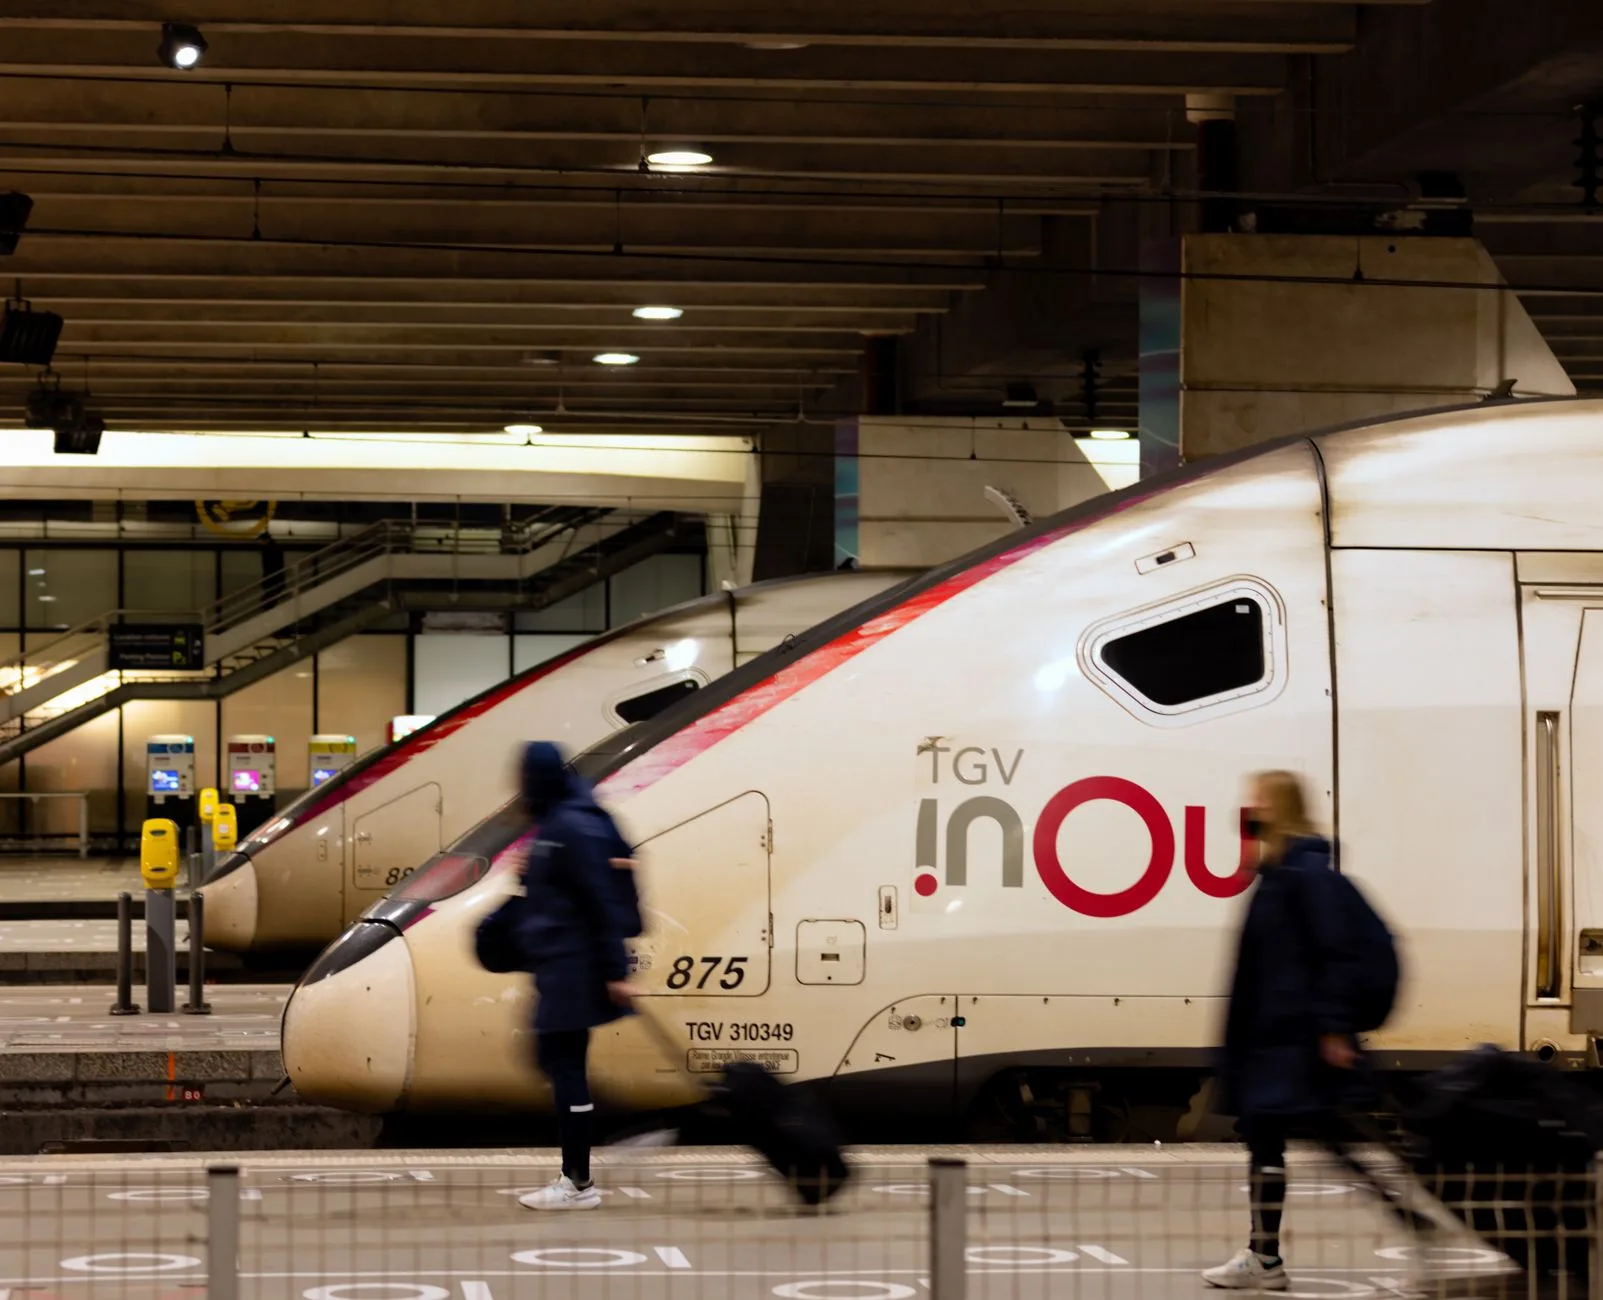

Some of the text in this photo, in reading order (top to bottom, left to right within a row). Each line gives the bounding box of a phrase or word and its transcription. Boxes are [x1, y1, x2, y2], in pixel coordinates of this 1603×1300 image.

[927, 746, 1025, 785] TGV
[667, 956, 748, 990] 875
[686, 1022, 793, 1041] TGV 310349
[185, 1090, 201, 1100] 80
